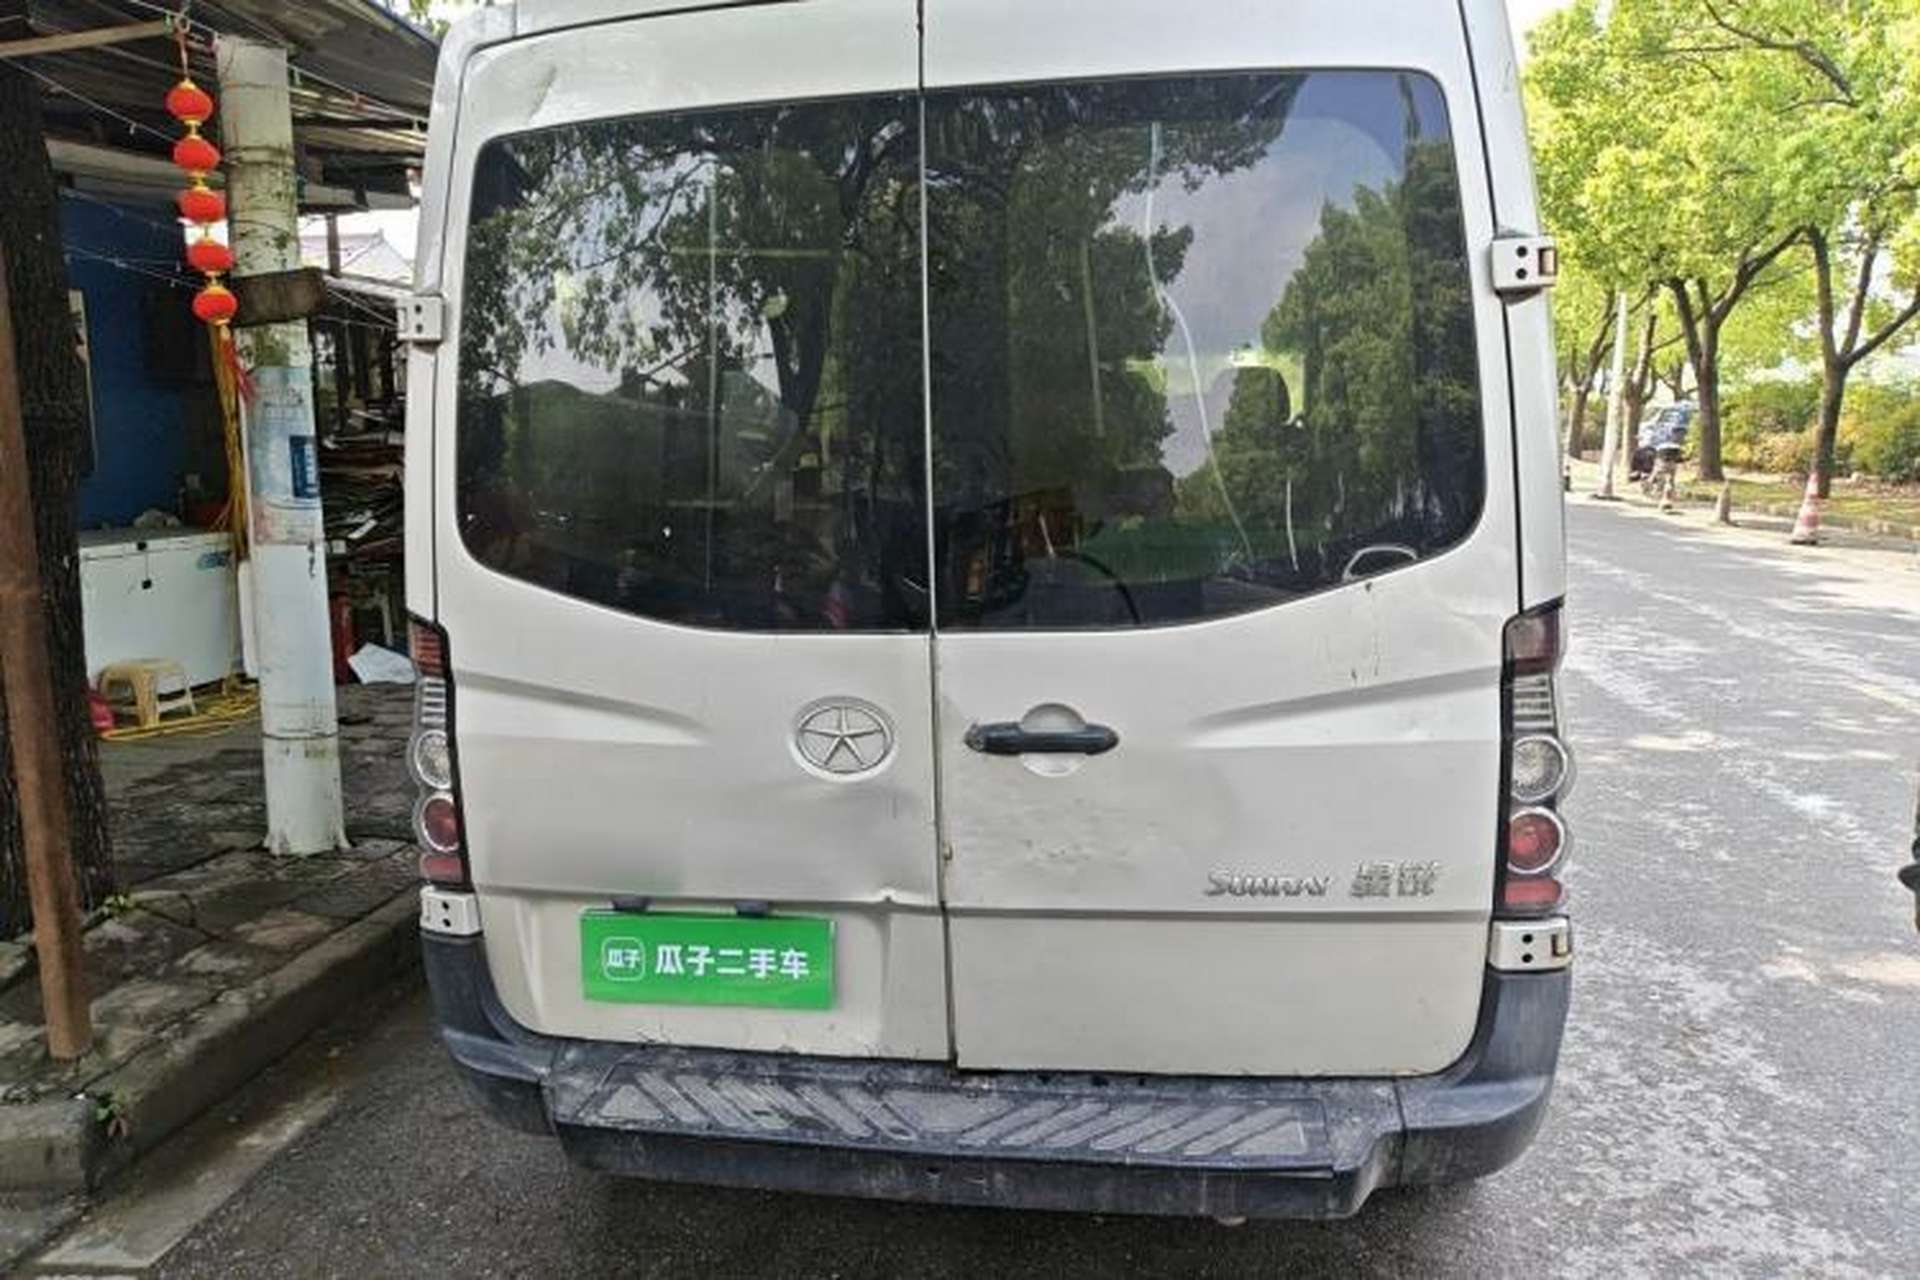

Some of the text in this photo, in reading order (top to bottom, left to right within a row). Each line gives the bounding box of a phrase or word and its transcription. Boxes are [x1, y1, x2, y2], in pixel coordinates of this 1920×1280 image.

[606, 945, 809, 980] 瓜子 瓜子二手车
